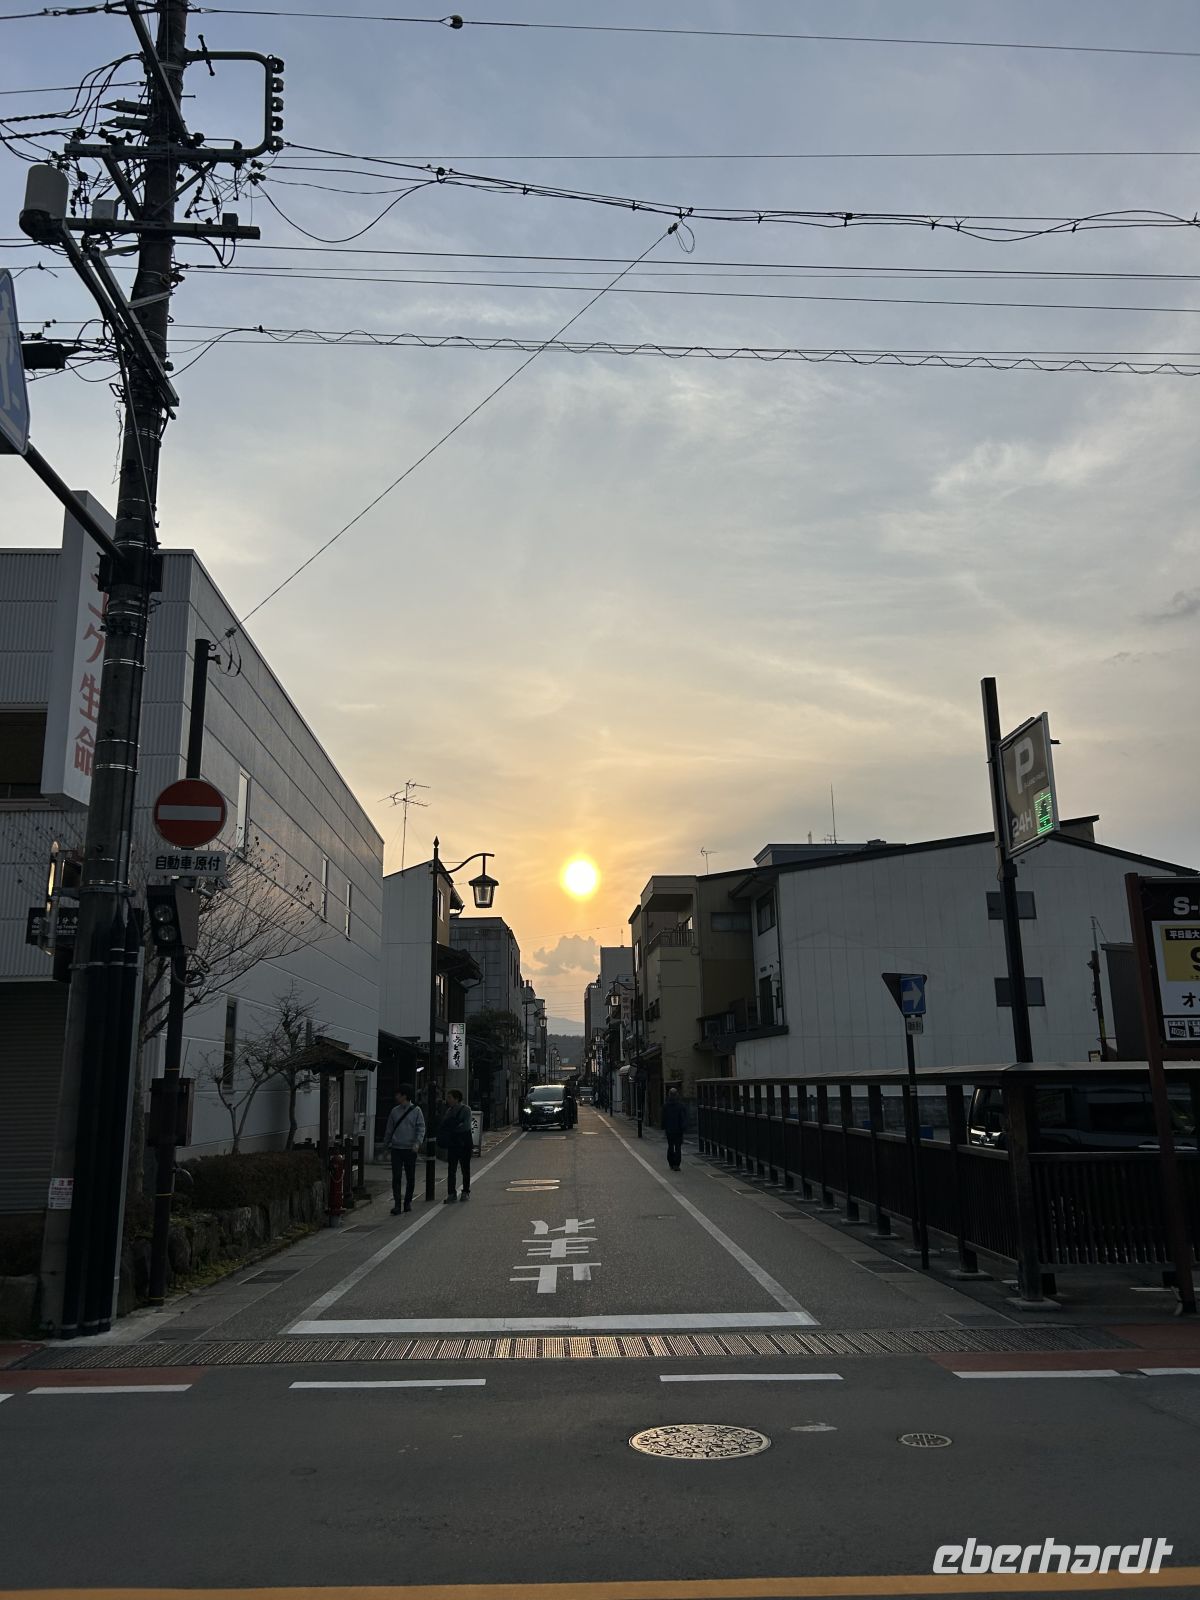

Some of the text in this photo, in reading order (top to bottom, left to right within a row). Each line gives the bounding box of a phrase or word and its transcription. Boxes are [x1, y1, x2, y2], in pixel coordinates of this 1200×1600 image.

[1013, 736, 1035, 795] P
[1012, 808, 1033, 838] 24H
[155, 855, 221, 871] 自動車・原付
[1173, 896, 1200, 916] S-
